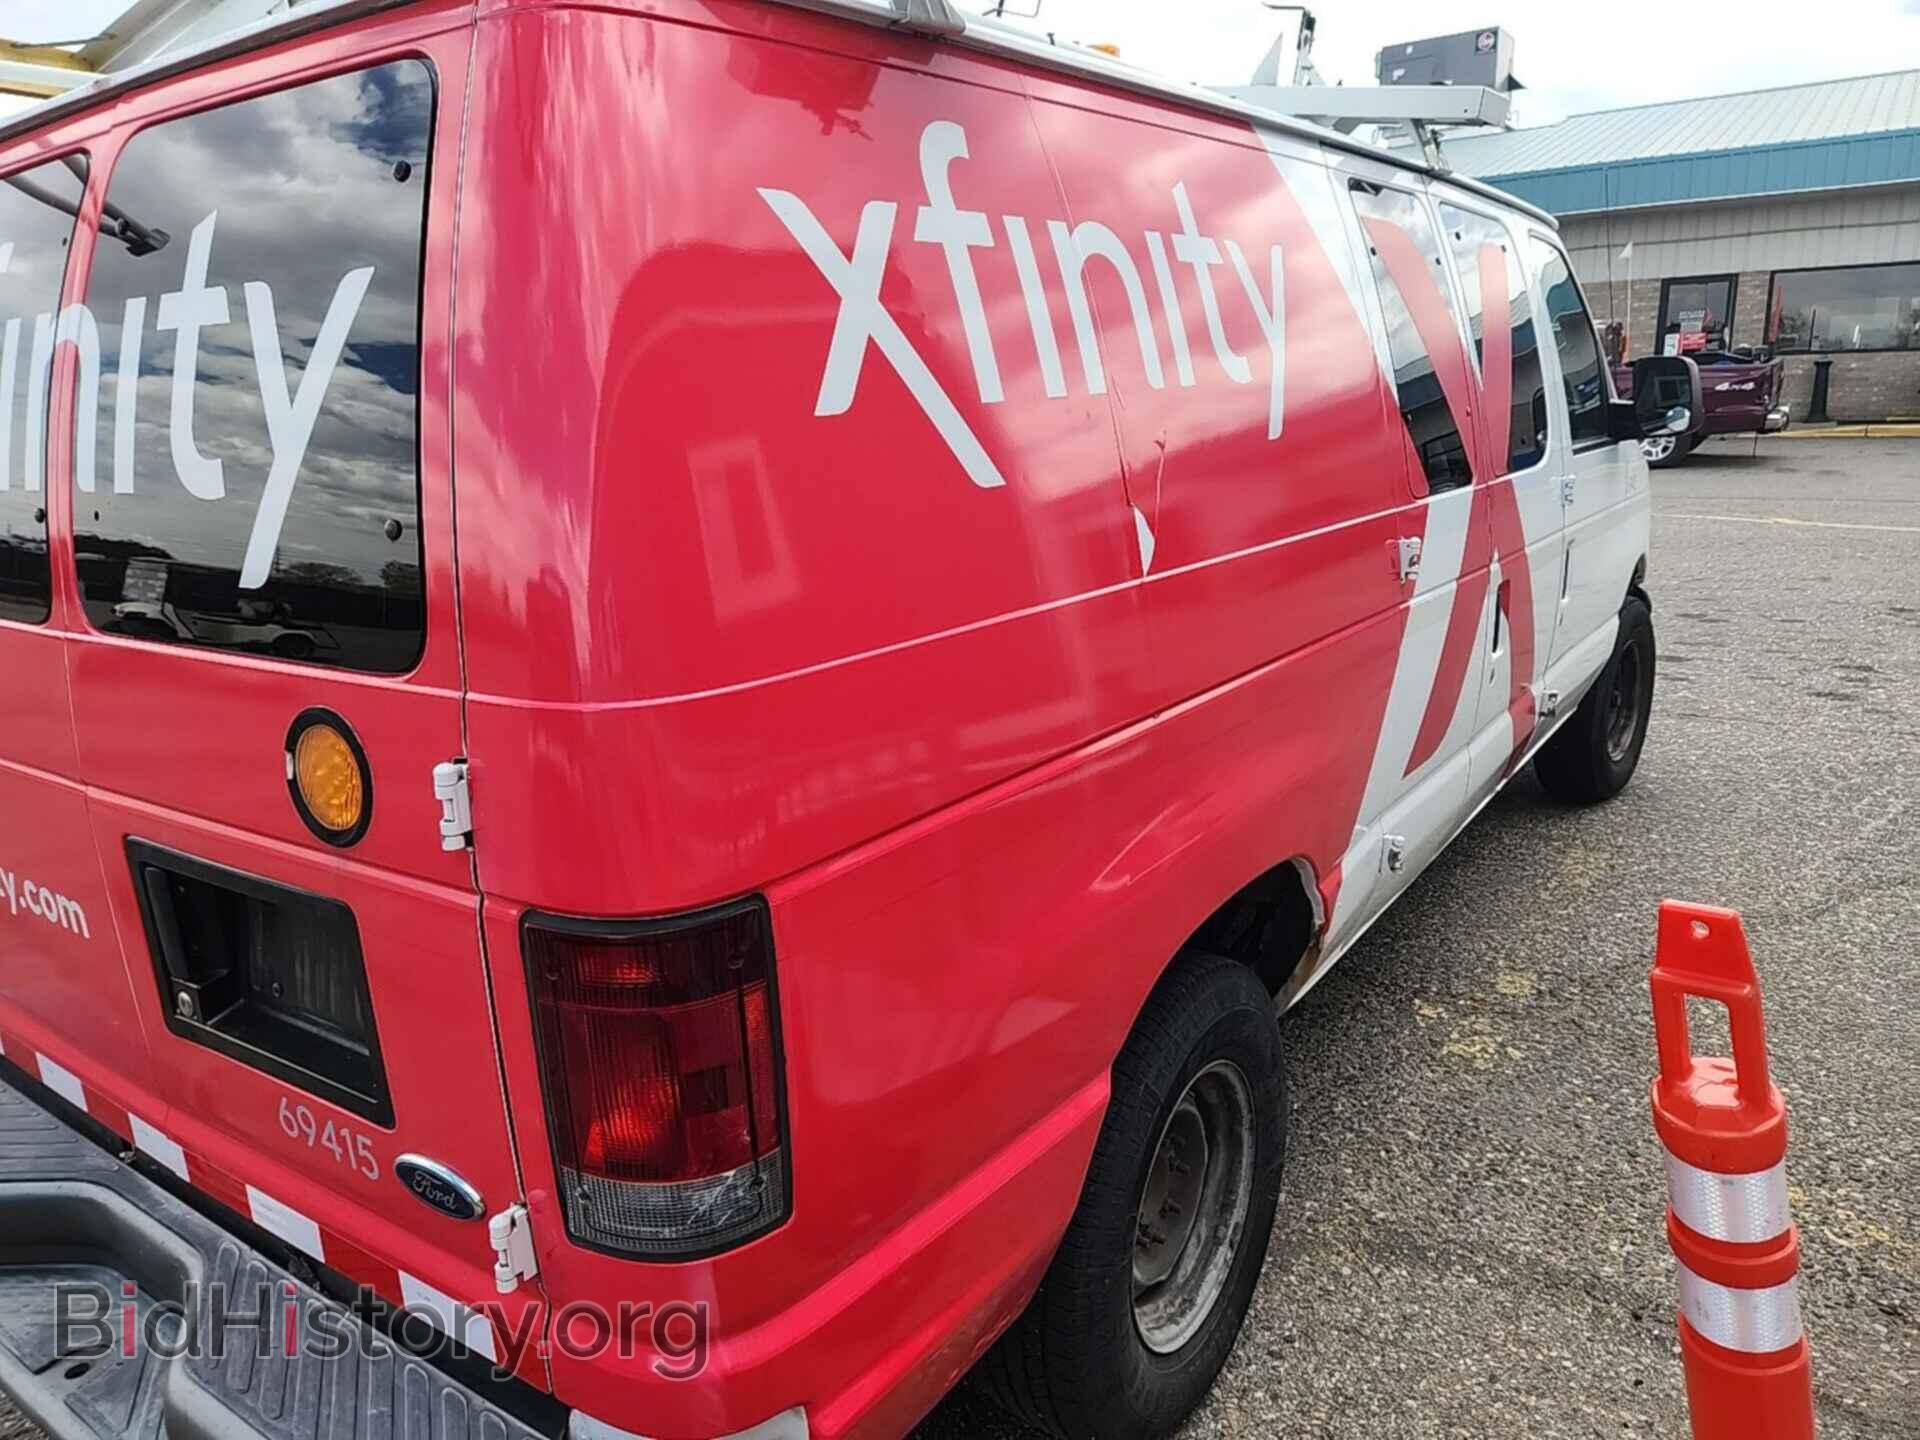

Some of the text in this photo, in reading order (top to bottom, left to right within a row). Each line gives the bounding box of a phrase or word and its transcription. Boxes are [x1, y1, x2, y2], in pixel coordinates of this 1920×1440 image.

[755, 120, 1288, 489] xfinity
[0, 209, 376, 590] inity
[0, 866, 91, 939] y.com
[279, 1096, 380, 1181] 69415
[411, 1169, 460, 1211] Ford
